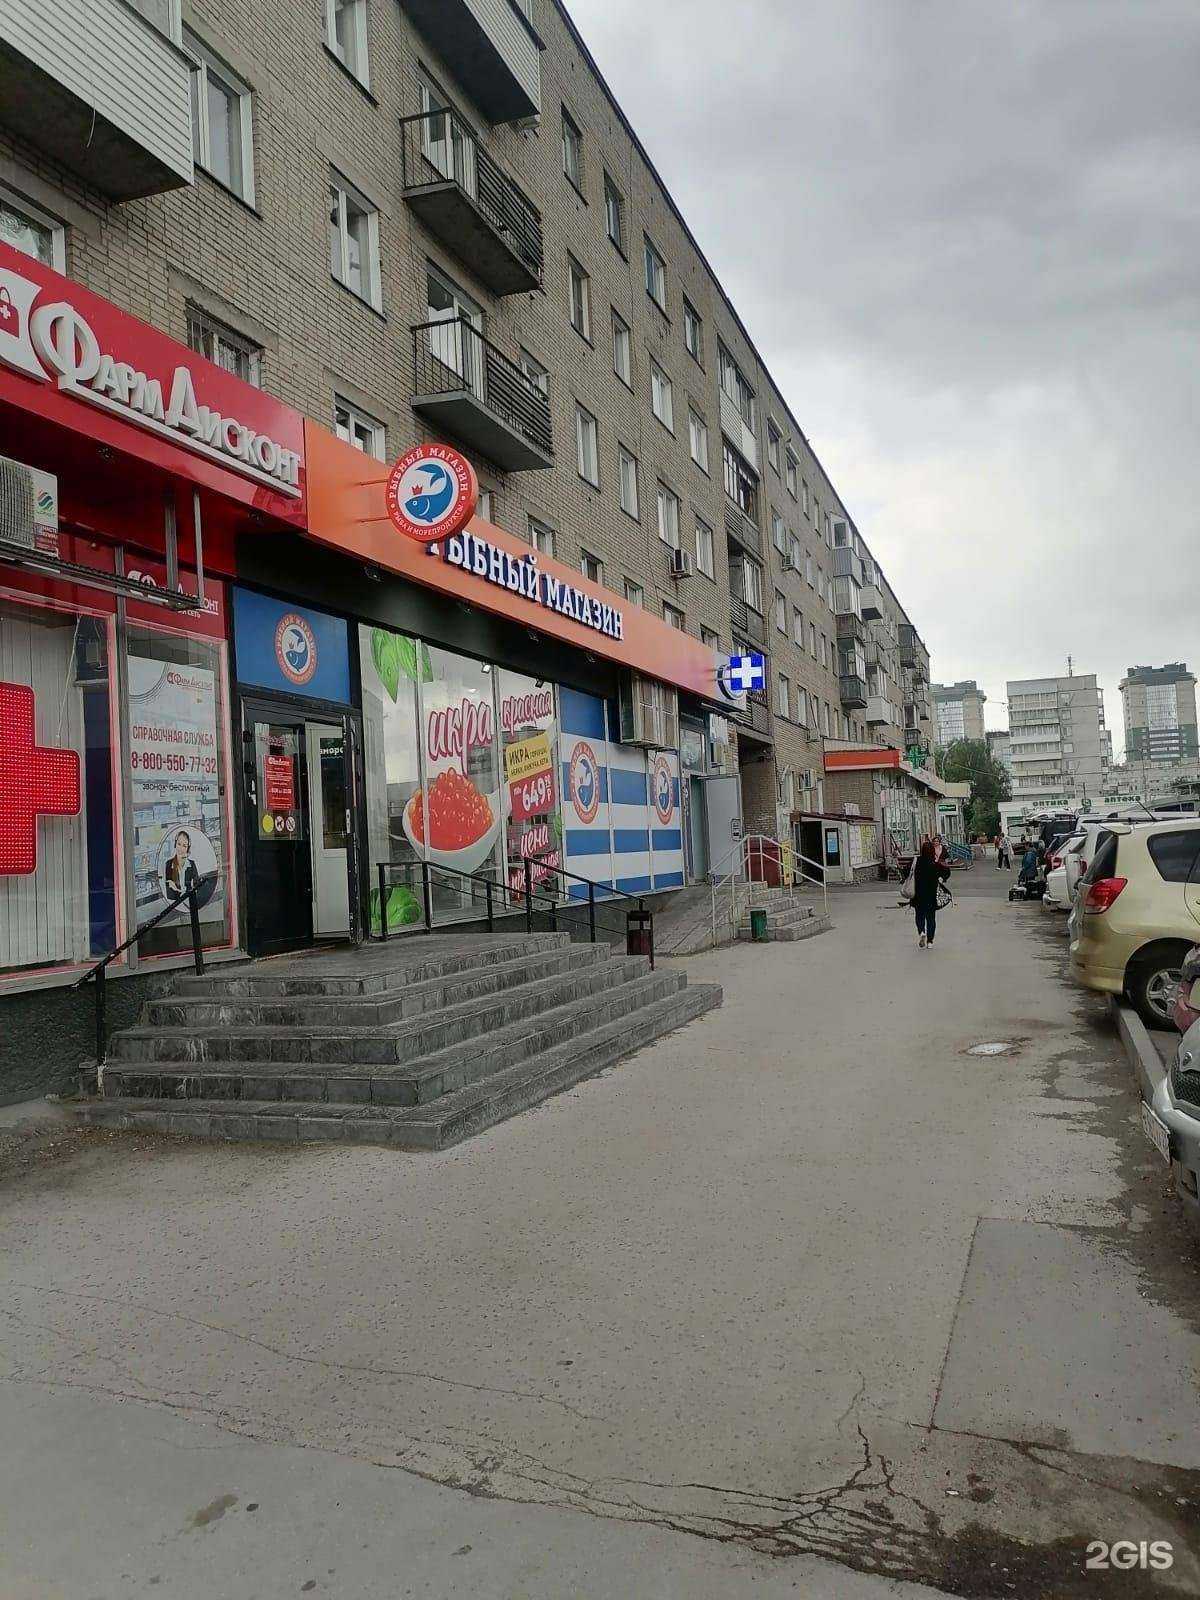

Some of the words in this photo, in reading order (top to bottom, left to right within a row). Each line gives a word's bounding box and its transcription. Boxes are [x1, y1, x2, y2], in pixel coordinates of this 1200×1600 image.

[389, 448, 424, 499] РЫБНЫЙ
[429, 447, 469, 492] МАГАЗИН
[429, 530, 542, 603] ЫБНЫЙ
[546, 574, 625, 641] МАГАЗИН
[132, 725, 183, 743] СПРАВОЧНАЯ
[184, 731, 214, 748] СЛУЖБА
[428, 698, 494, 780] икра
[131, 751, 217, 774] 8-800-550-77-32
[522, 777, 546, 812] 649
[1032, 799, 1069, 807] оптика
[1104, 795, 1141, 803] аптека
